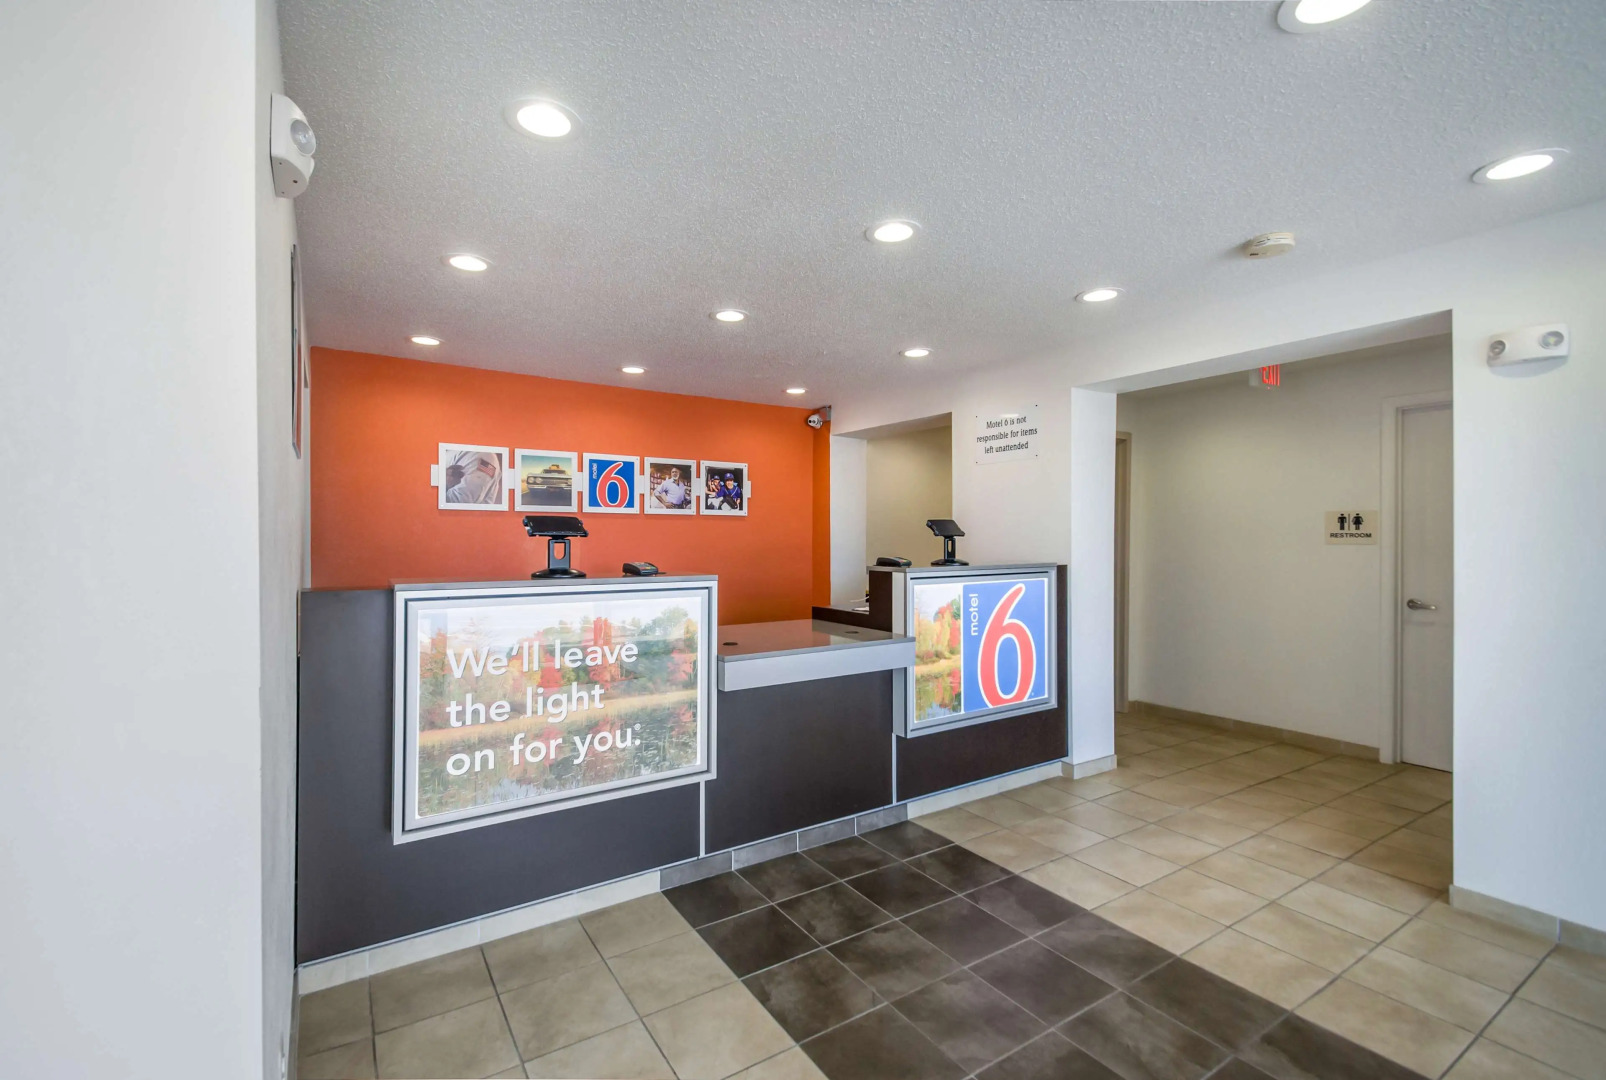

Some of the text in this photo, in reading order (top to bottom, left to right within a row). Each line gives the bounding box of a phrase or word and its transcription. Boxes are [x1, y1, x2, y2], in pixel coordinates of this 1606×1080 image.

[976, 427, 1038, 443] responsible for items
[986, 416, 1027, 429] Motel 6 is not
[984, 441, 1029, 454] left unattended
[596, 461, 630, 508] 6
[968, 593, 979, 636] motel
[446, 639, 639, 679] We'll leave
[977, 583, 1037, 708] 6
[445, 681, 605, 728] the light
[446, 748, 495, 776] on
[509, 732, 563, 766] for
